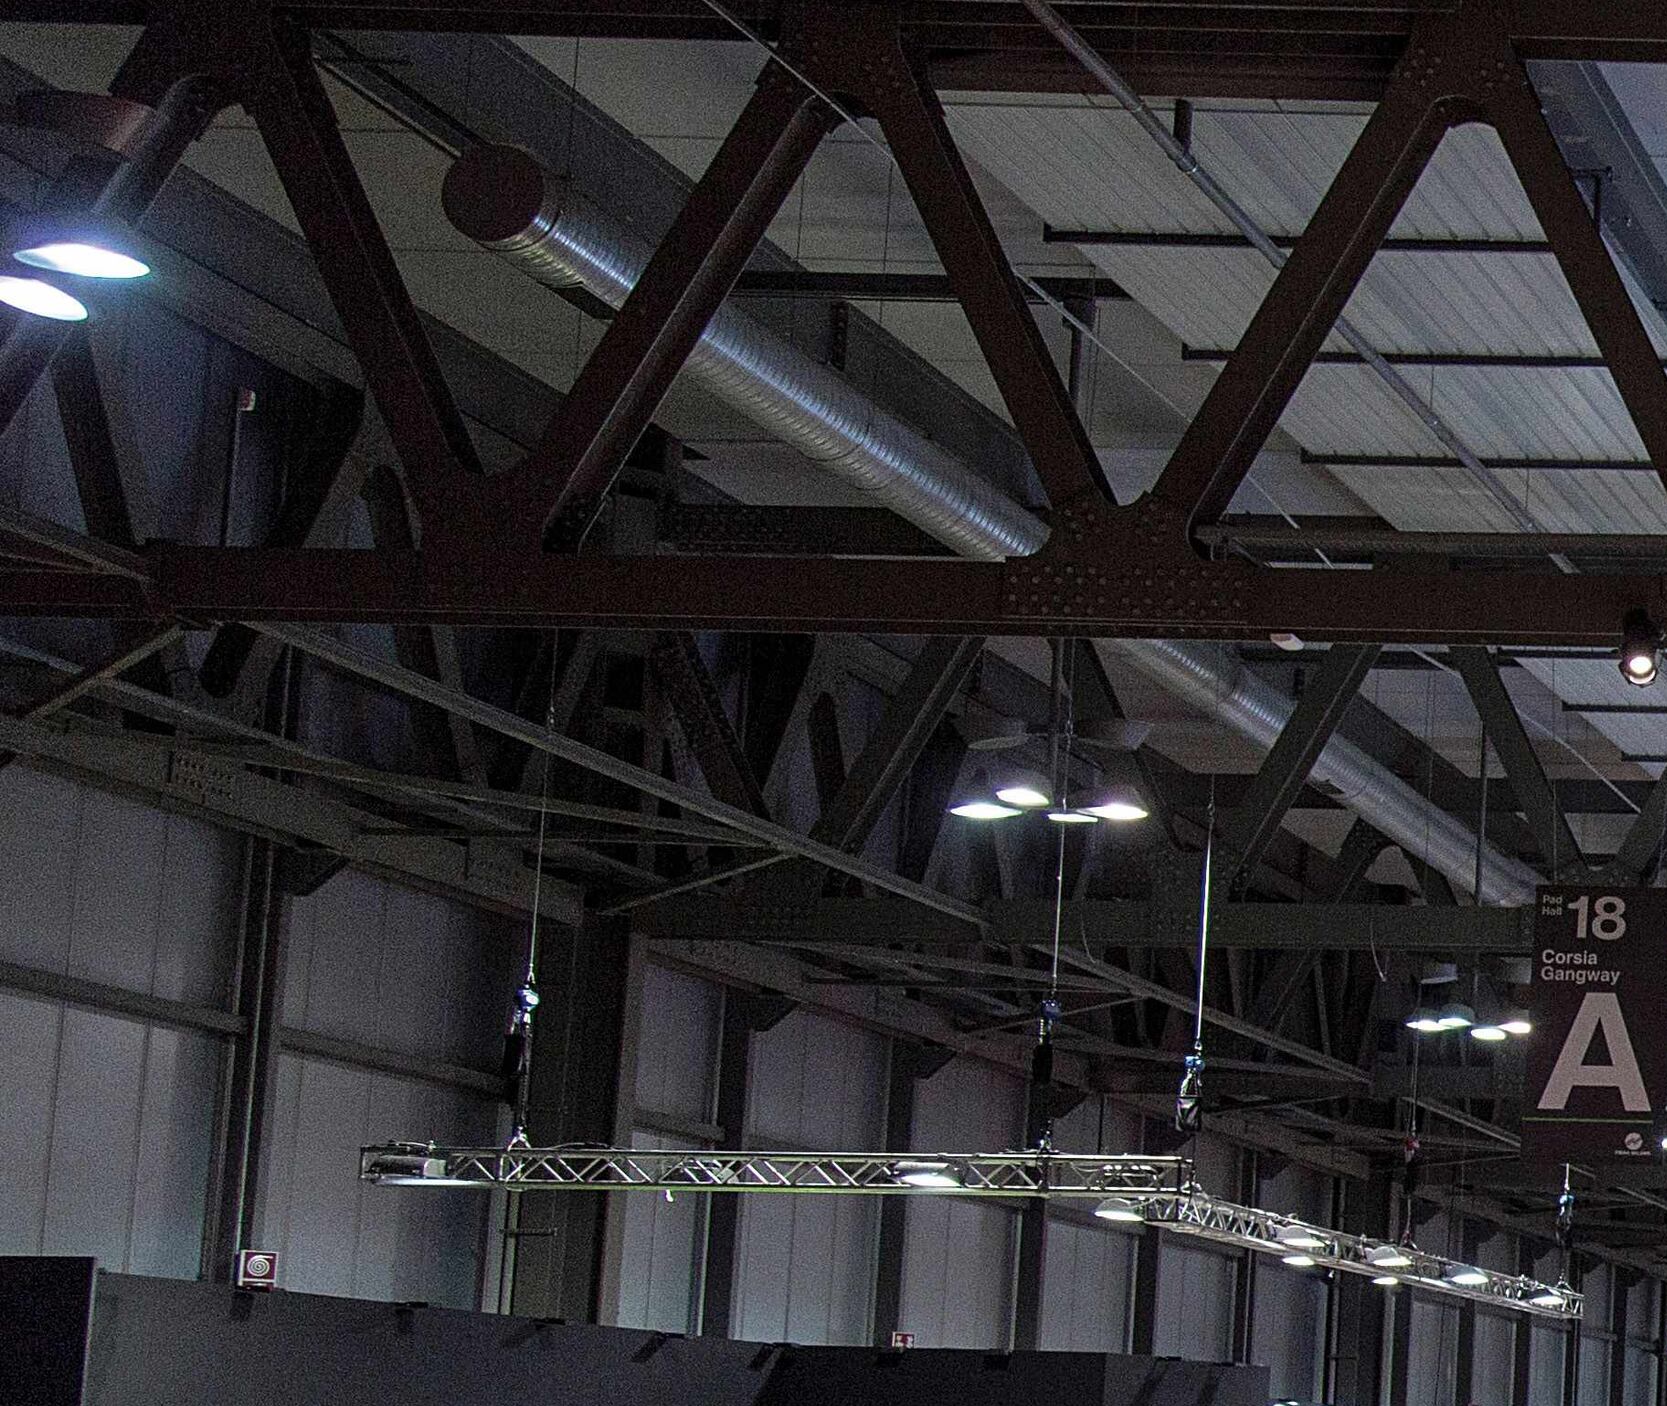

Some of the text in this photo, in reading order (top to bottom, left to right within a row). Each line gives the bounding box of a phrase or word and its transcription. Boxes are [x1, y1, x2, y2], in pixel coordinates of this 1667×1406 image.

[1567, 894, 1627, 941] 18
[1541, 948, 1598, 965] Corsia
[1540, 966, 1621, 985] Gangway
[1536, 991, 1651, 1112] A
